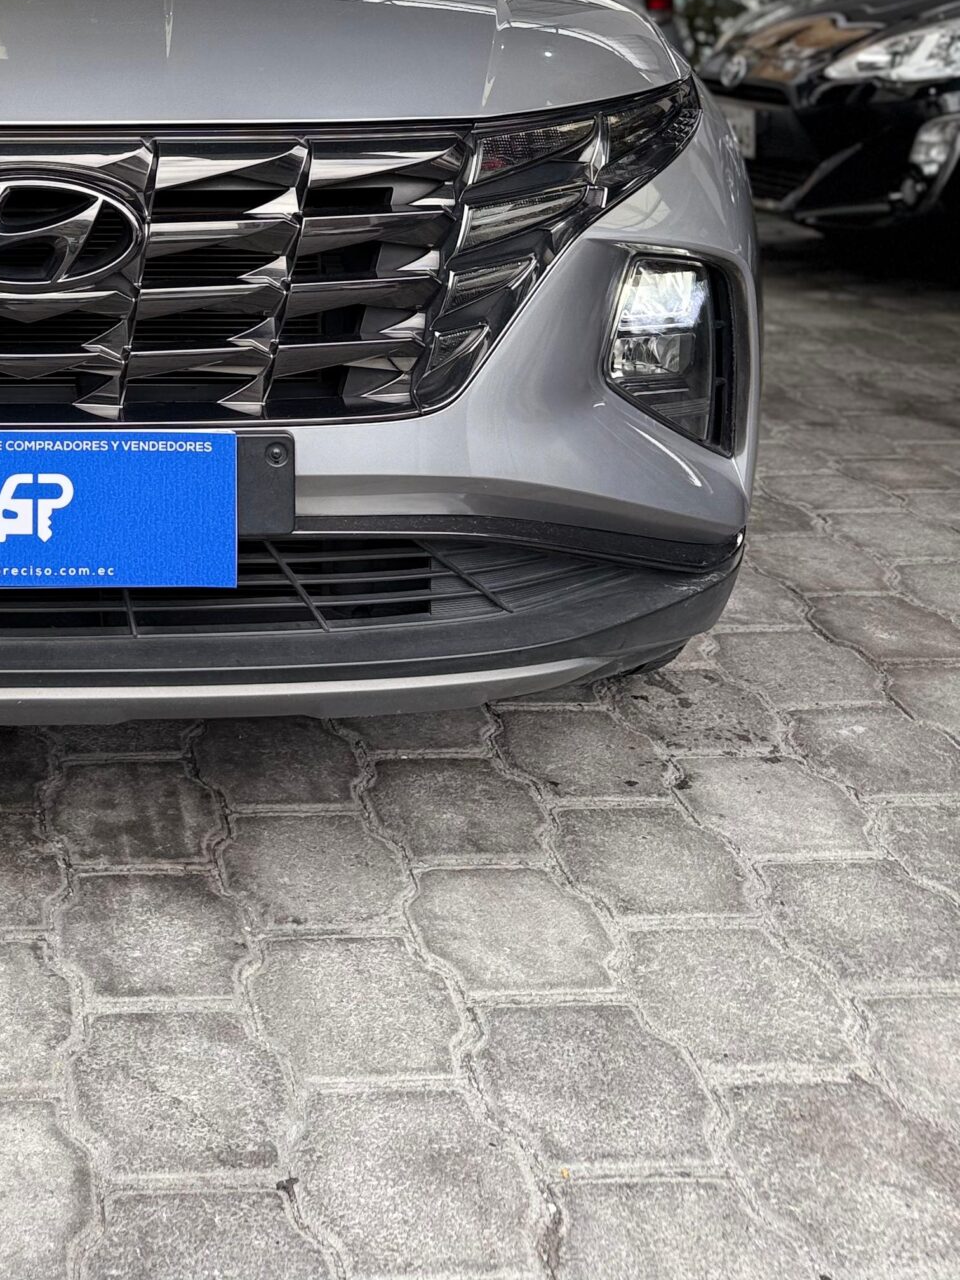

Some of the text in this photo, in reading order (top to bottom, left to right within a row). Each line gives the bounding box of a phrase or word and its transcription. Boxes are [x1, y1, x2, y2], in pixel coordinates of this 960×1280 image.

[5, 440, 108, 451] COMPRADORES
[111, 441, 121, 451] Y
[122, 441, 212, 452] VENDEDORES
